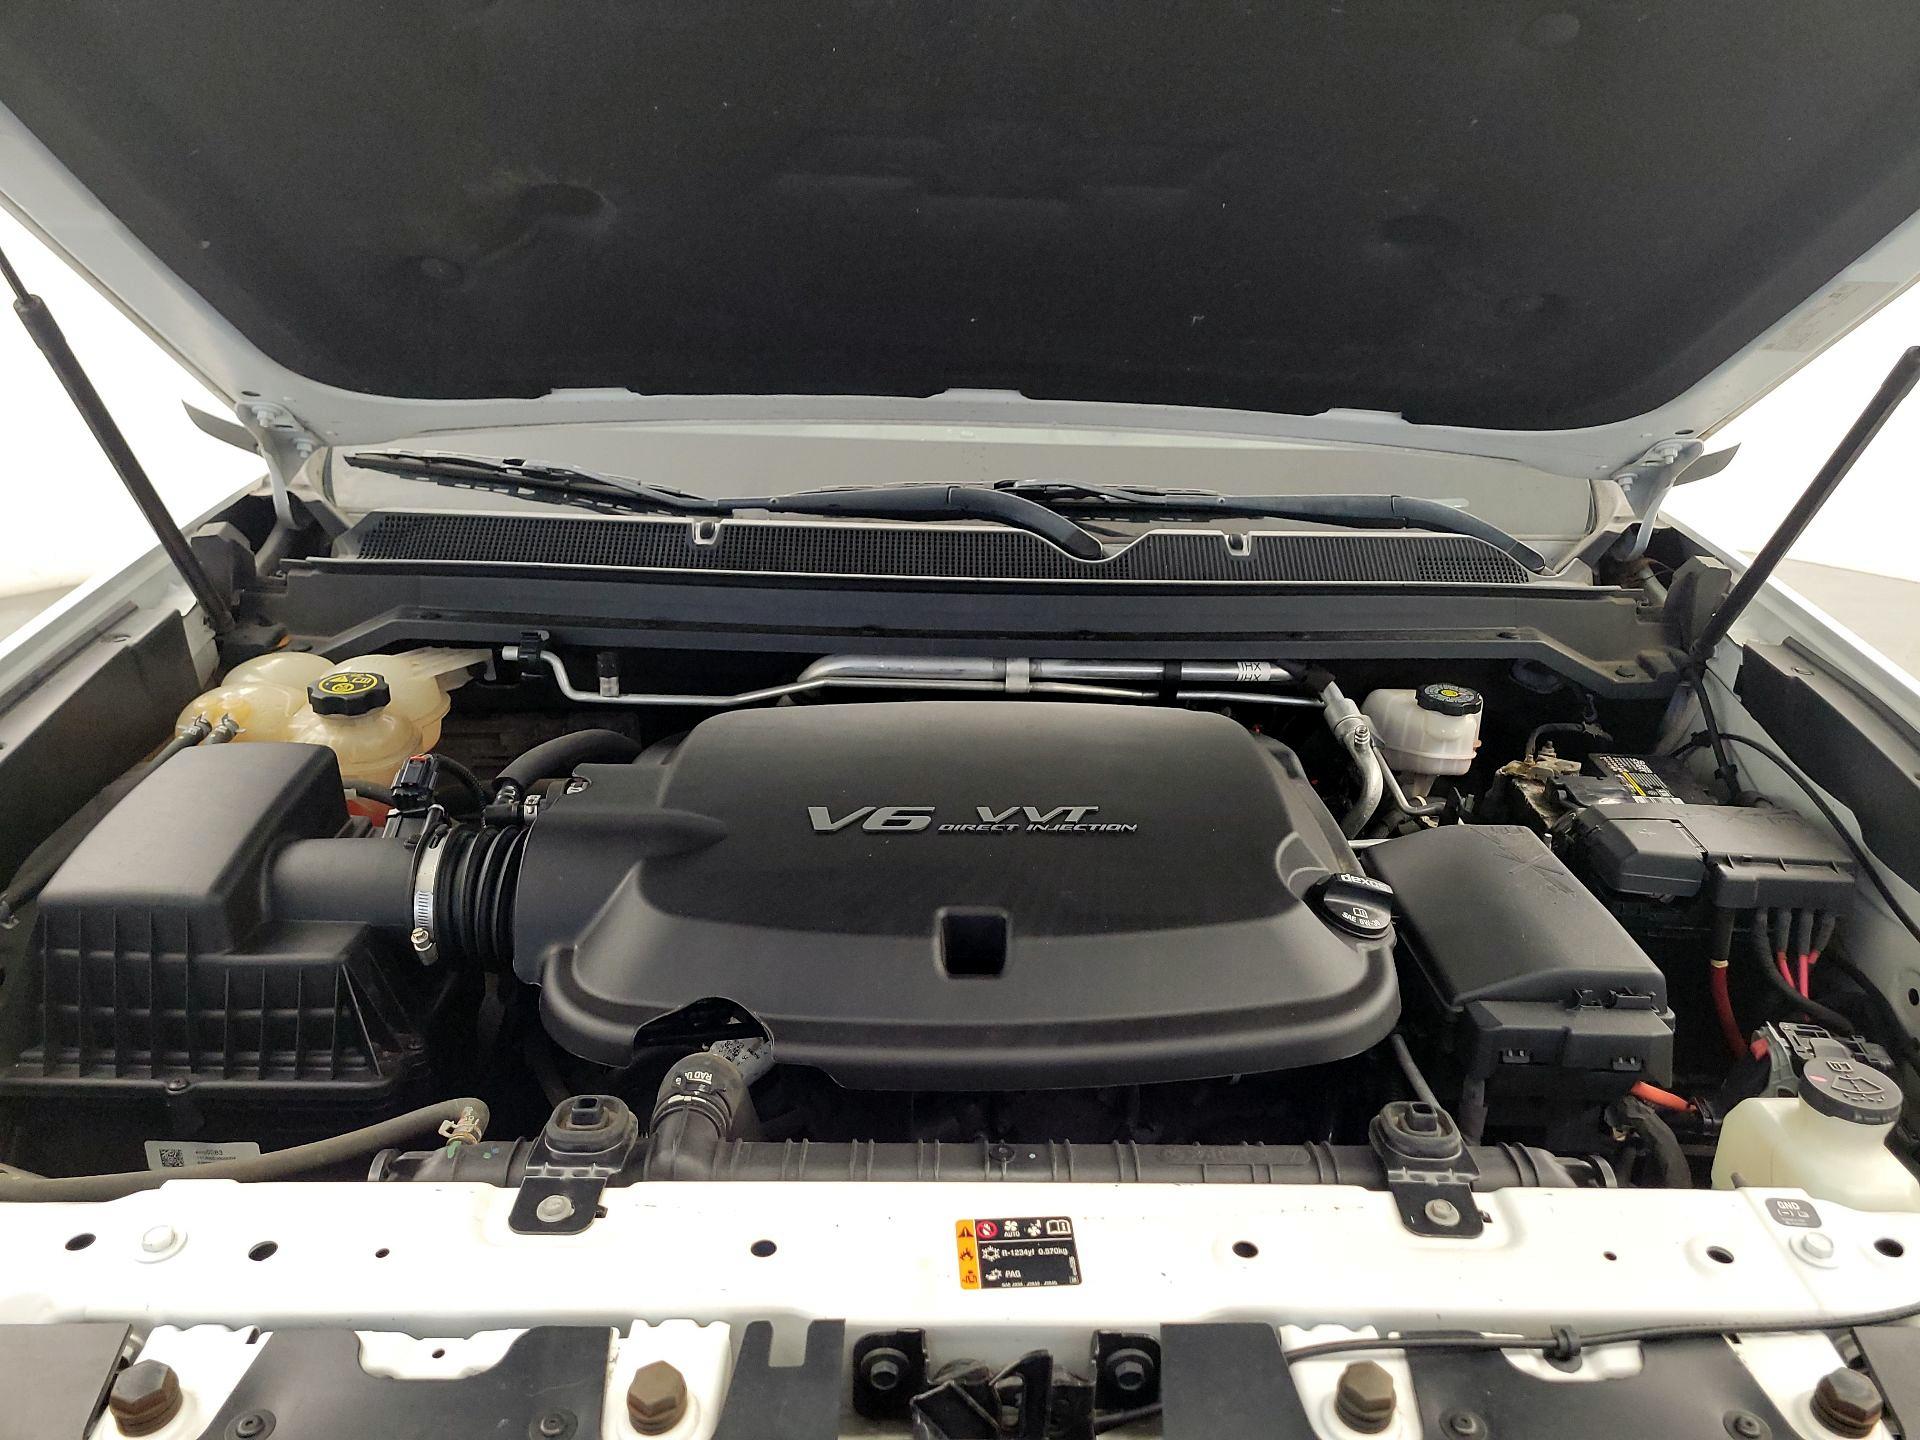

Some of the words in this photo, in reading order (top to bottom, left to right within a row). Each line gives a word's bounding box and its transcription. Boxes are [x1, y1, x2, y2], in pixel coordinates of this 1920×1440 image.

[807, 806, 936, 832] V6
[976, 806, 1099, 823] VVT
[937, 823, 1019, 833] DIRECT
[1026, 823, 1139, 834] INJECTION
[1341, 911, 1357, 923] SAE
[694, 1071, 713, 1081] RAD
[1776, 1200, 1800, 1210] GND
[1005, 1269, 1022, 1278] PAG
